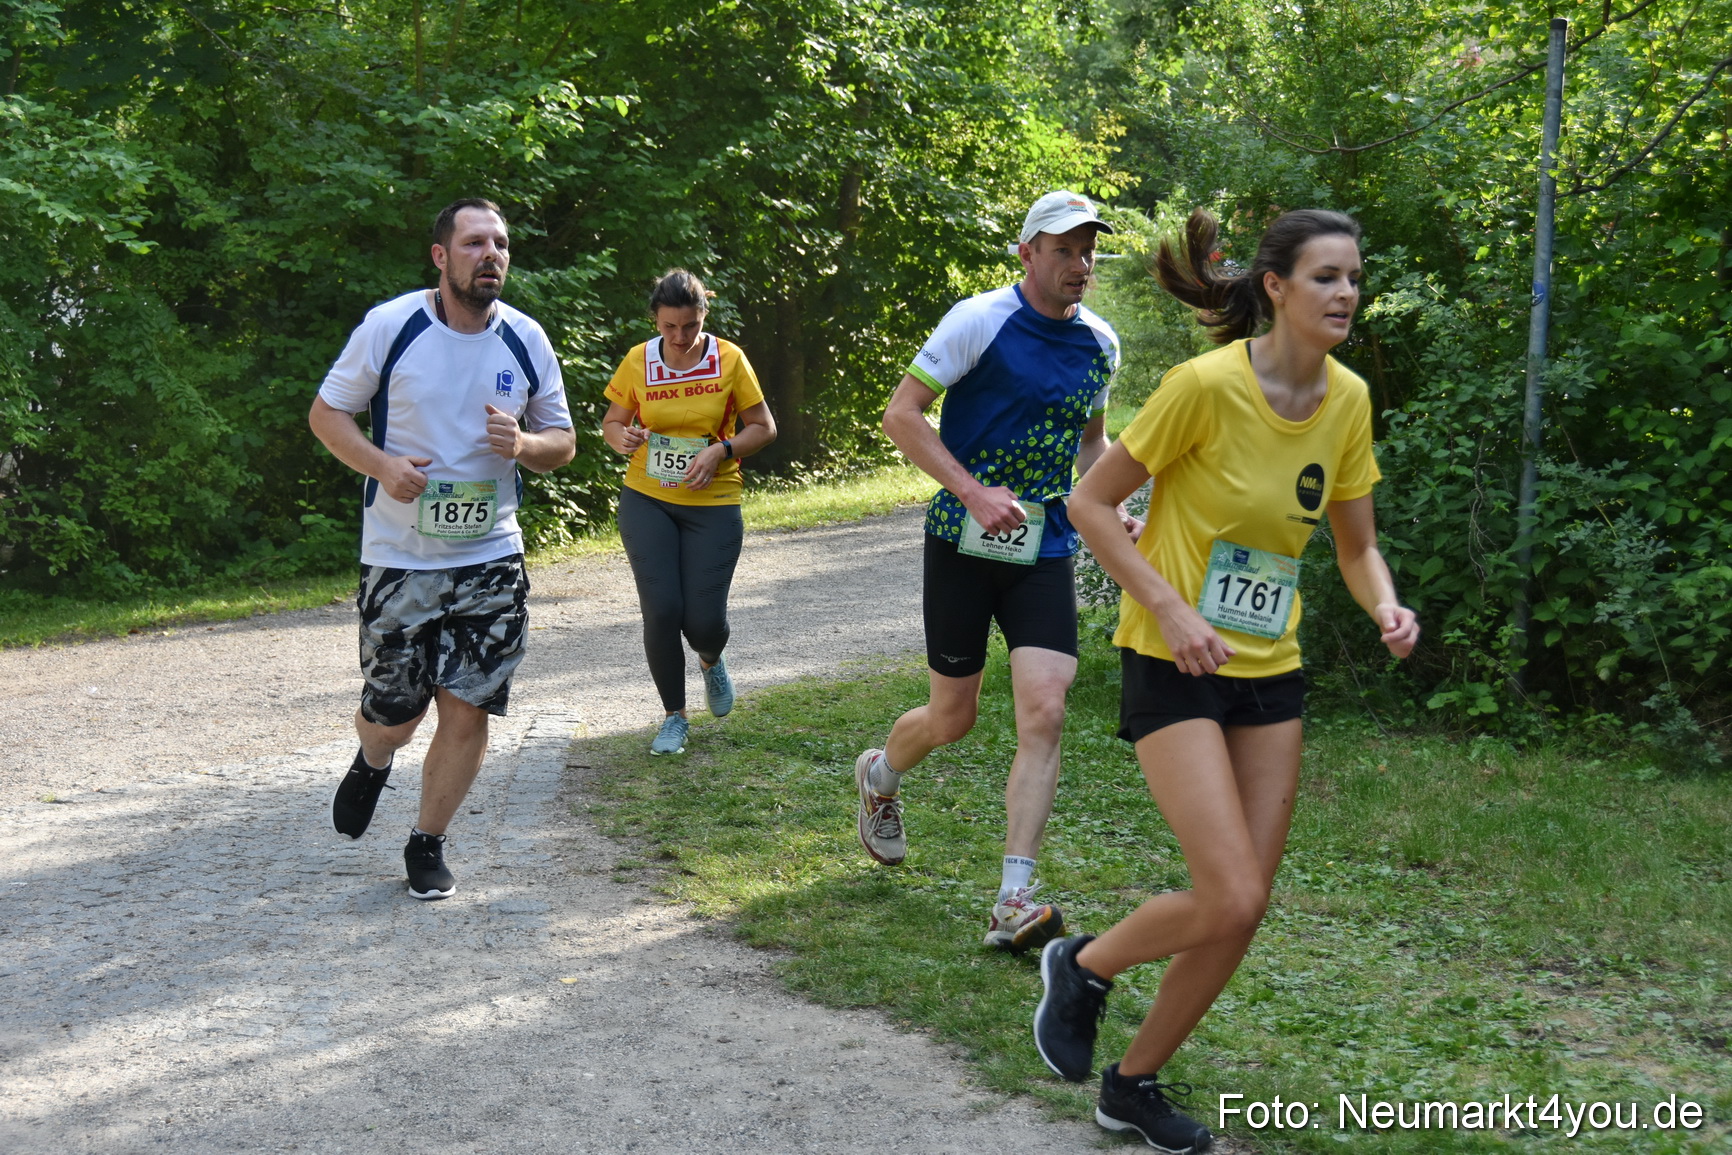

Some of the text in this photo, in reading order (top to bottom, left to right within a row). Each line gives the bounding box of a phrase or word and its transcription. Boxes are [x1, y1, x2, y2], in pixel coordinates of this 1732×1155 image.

[646, 383, 723, 401] MAX BÖGL
[430, 501, 489, 523] 1875
[982, 541, 1022, 553] Lehner Heiko
[1218, 573, 1282, 615] 1761
[1217, 604, 1273, 624] Hummel Melanie
[1239, 618, 1260, 628] Apotheke
